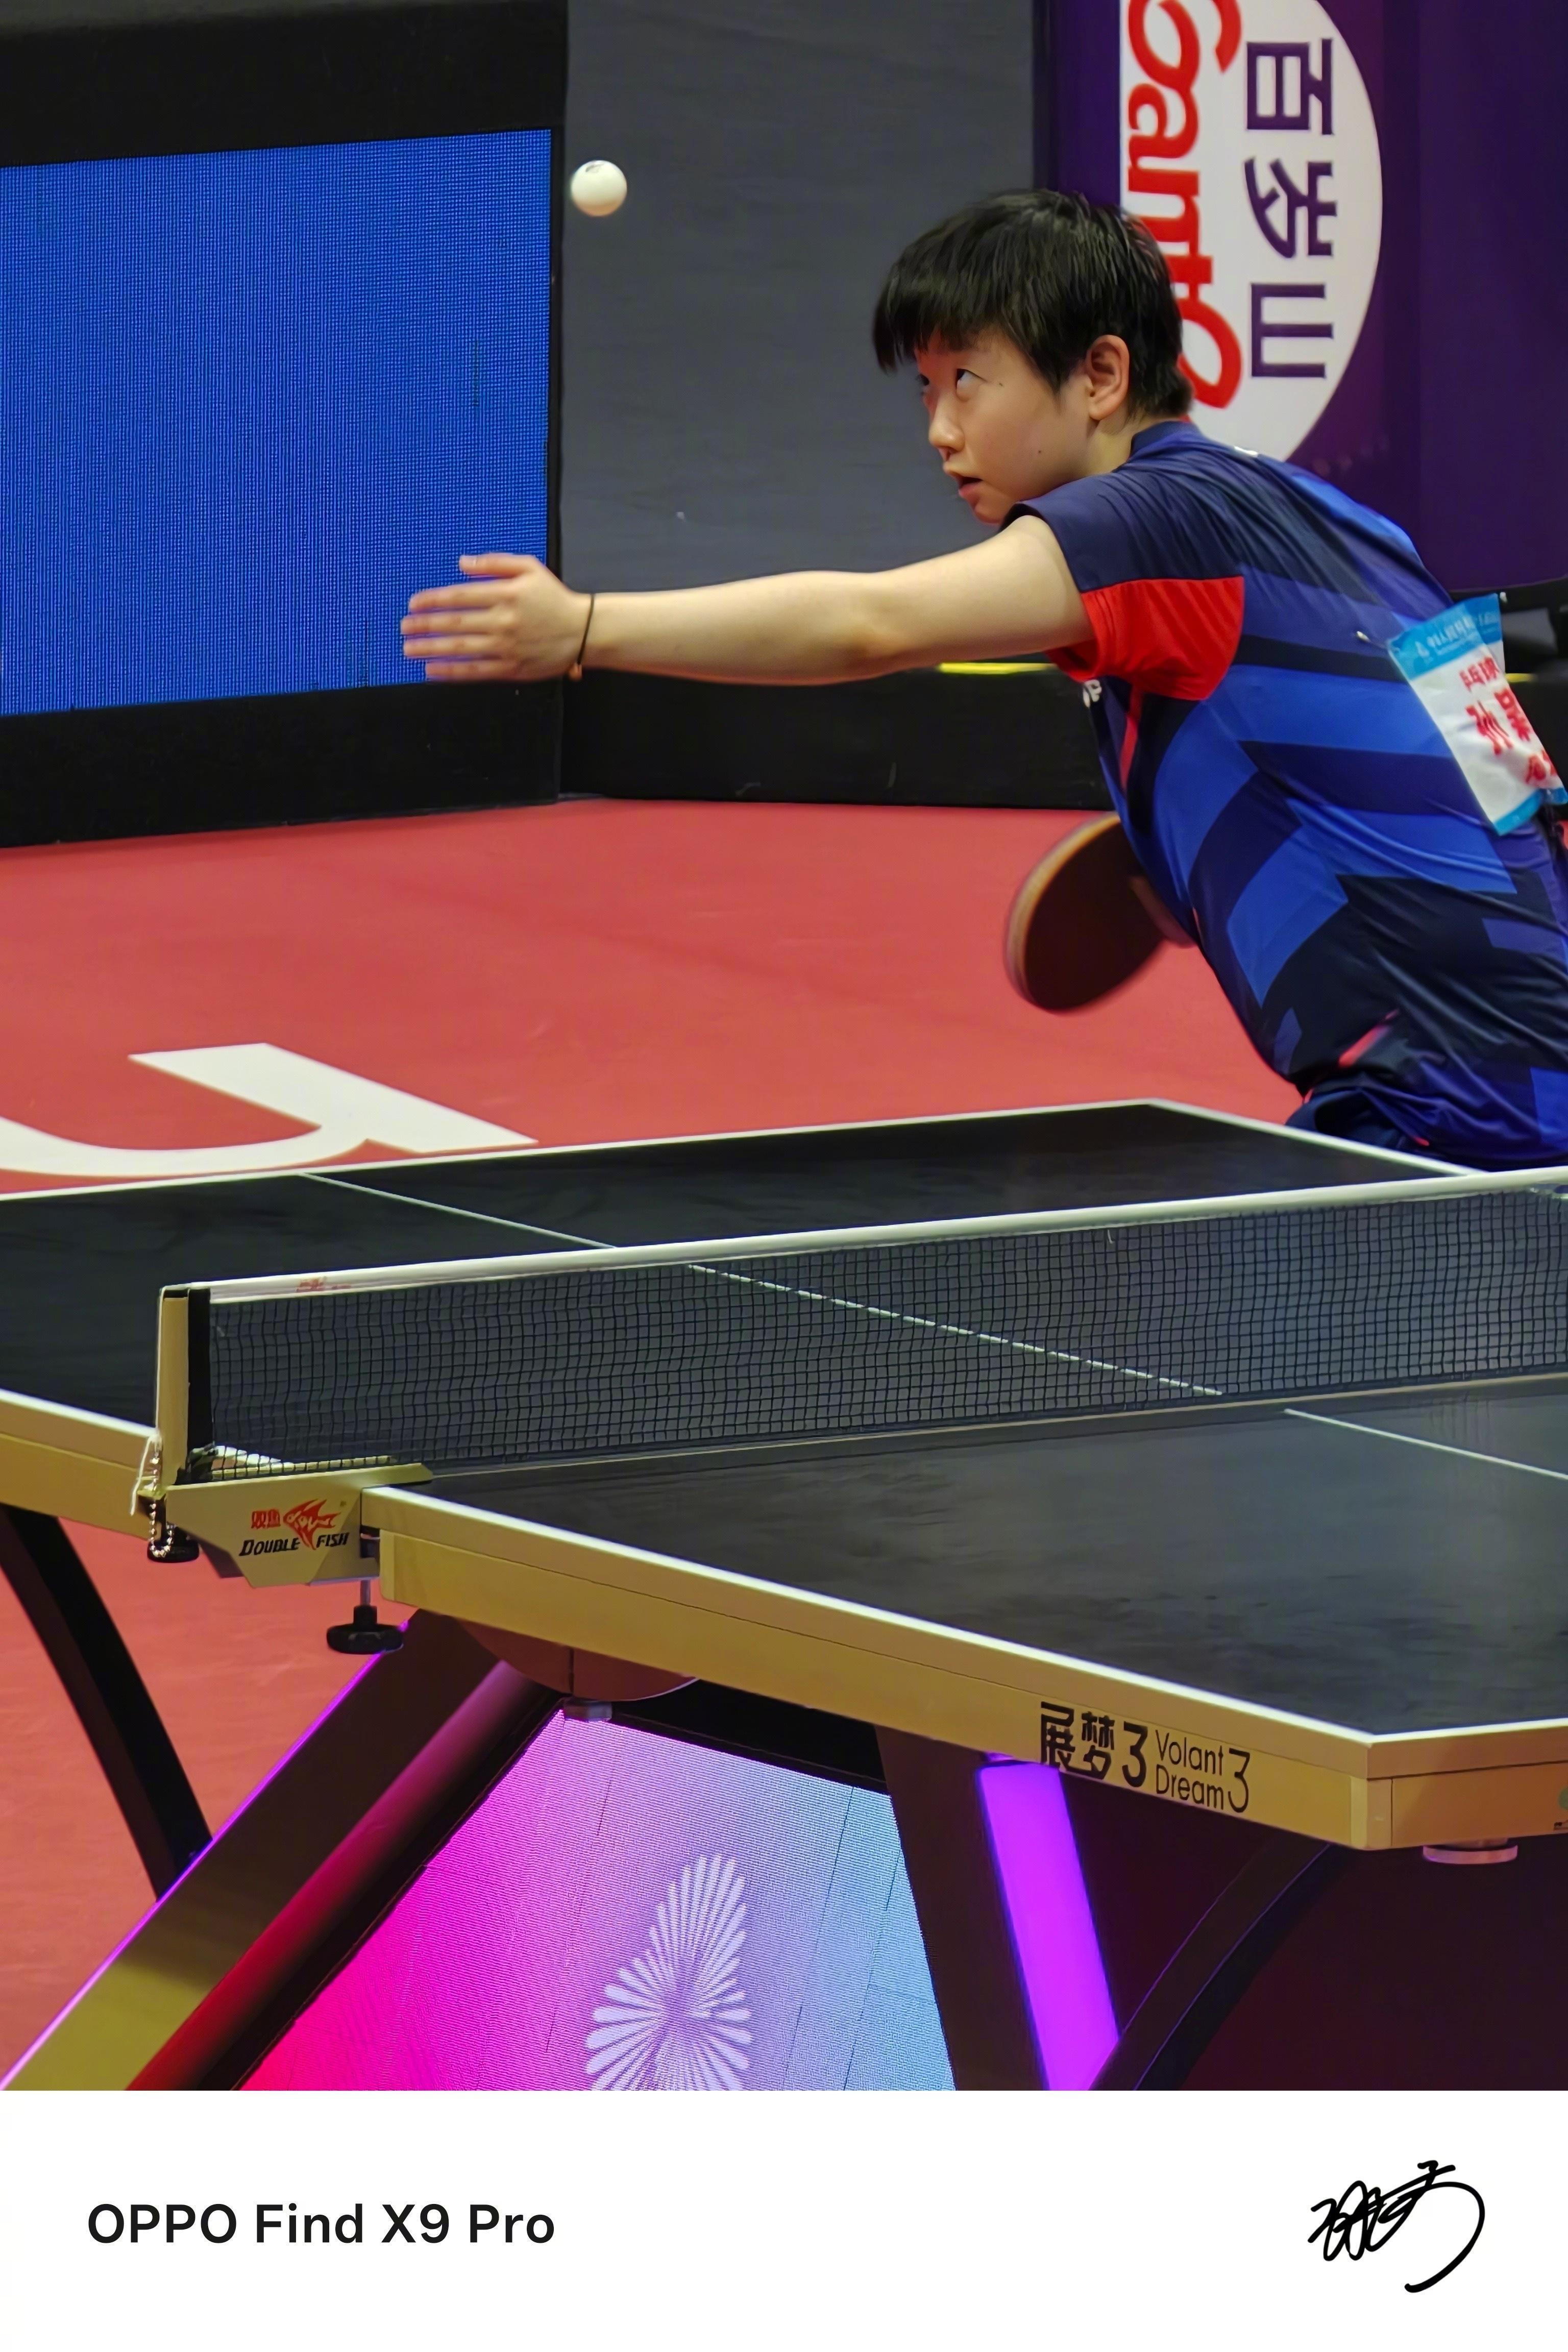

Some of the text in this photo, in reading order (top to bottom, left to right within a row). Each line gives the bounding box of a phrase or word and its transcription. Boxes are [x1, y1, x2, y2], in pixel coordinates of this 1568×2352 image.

[1244, 38, 1337, 379] 百岁山
[316, 1532, 350, 1548] FISH
[1155, 1729, 1224, 1776] Volant
[1156, 1764, 1224, 1810] Dream
[1228, 1748, 1251, 1813] 3
